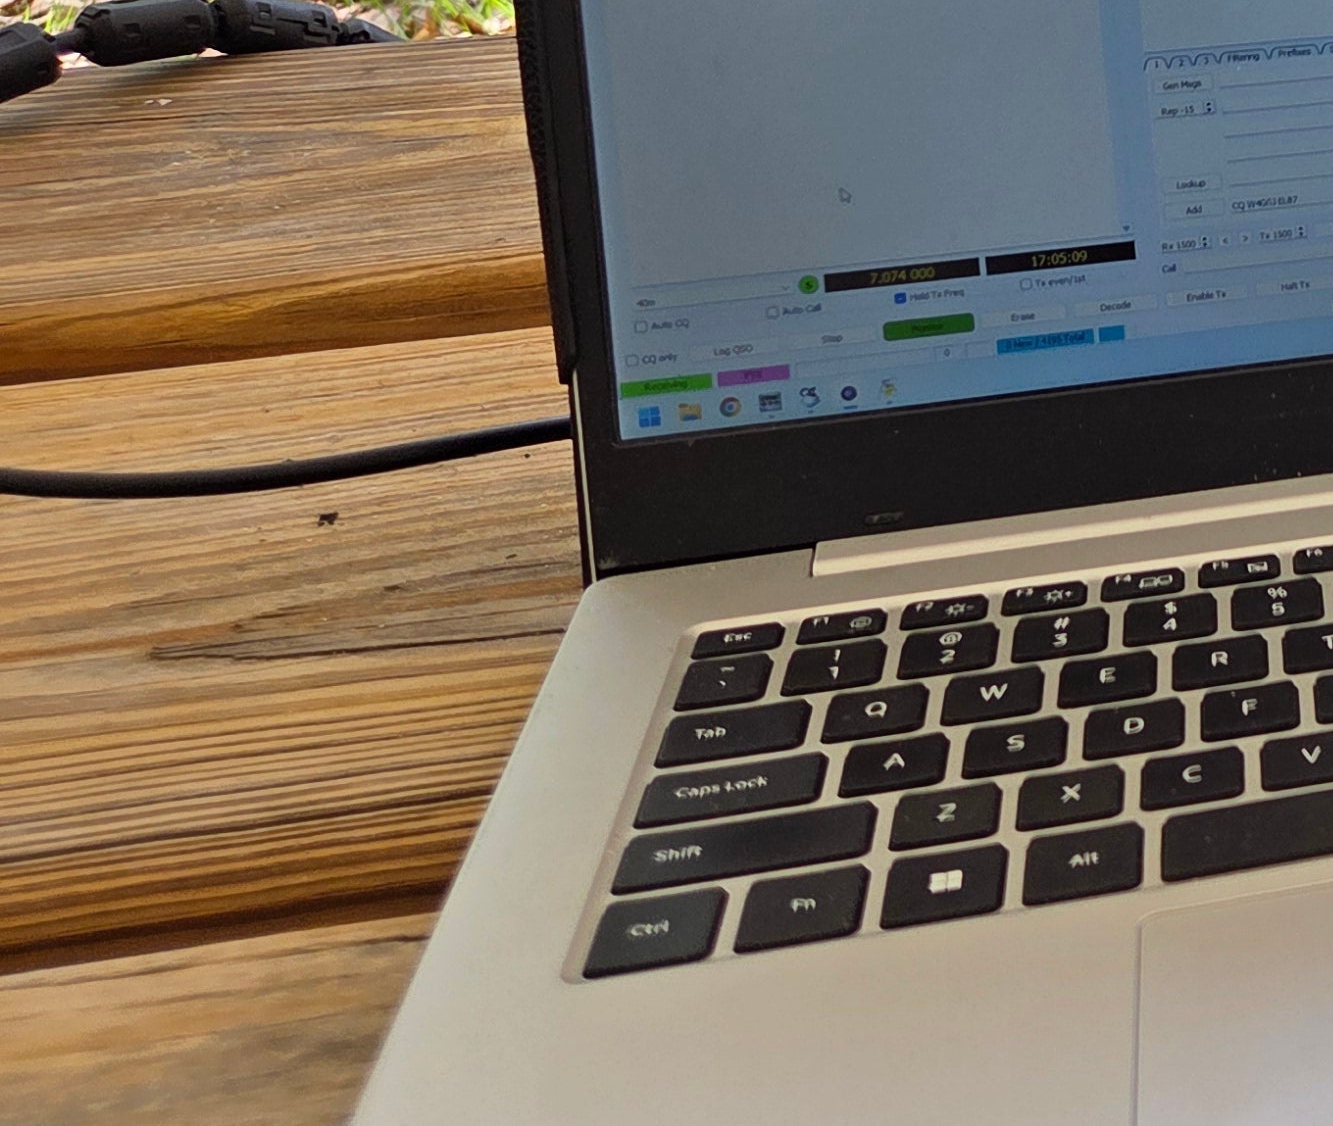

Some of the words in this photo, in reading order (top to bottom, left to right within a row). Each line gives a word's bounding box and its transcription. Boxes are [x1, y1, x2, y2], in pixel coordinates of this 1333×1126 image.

[1185, 205, 1203, 215] Add
[1273, 229, 1293, 239] 1500
[1031, 249, 1088, 268] 17:05:09
[1100, 301, 1132, 312] Decode
[732, 343, 754, 354] QSO
[1271, 602, 1286, 617] 5
[1053, 633, 1069, 647] 3
[939, 650, 957, 663] 2
[1211, 651, 1229, 667] R
[1099, 667, 1117, 684] E
[979, 682, 1009, 701] W
[864, 701, 888, 719] Q
[1241, 698, 1258, 716] F
[694, 724, 727, 741] Tab
[1123, 716, 1145, 734] D
[1006, 735, 1026, 753] S
[883, 753, 906, 770] A
[1300, 745, 1322, 764] V
[1181, 764, 1203, 783] C
[673, 784, 721, 801] Caps
[724, 776, 768, 793] Lock
[1060, 783, 1082, 804] X
[935, 803, 957, 822] Z
[653, 845, 703, 863] Shift
[1068, 851, 1099, 868] Alt
[628, 919, 670, 936] Ctrl
